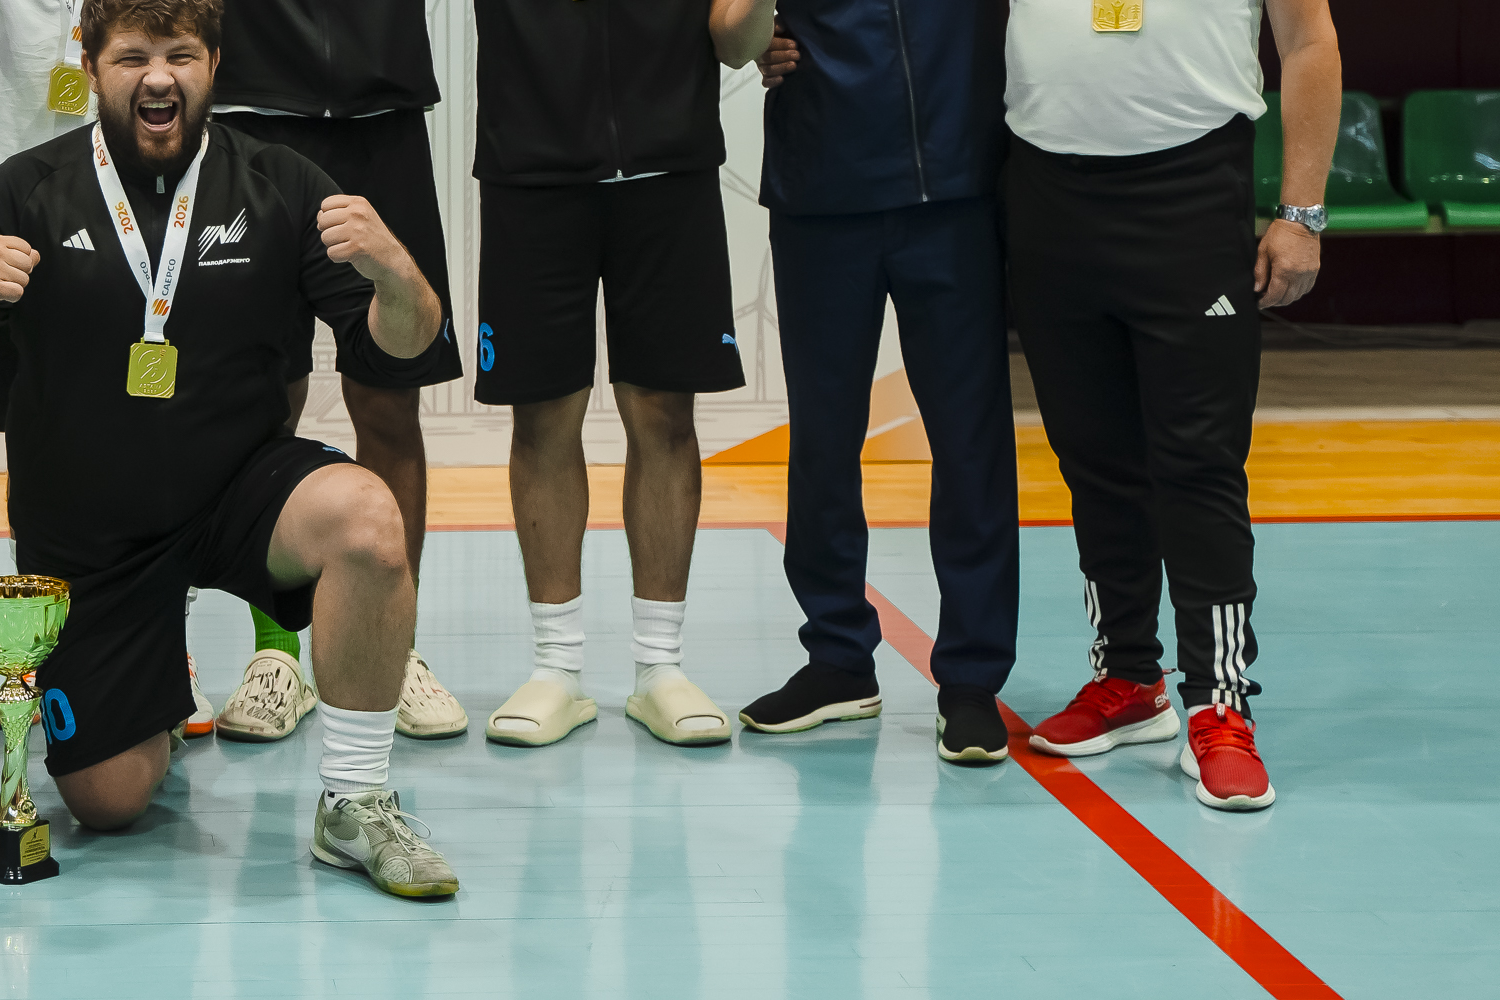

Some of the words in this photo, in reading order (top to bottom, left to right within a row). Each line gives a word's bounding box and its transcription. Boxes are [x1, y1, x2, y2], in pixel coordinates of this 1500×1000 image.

[115, 201, 134, 235] 2026
[173, 195, 189, 229] 2026
[161, 258, 177, 297] CAEPCO
[198, 257, 251, 267] ПАВЛОДАРЭНЕРГО
[479, 322, 495, 372] 6
